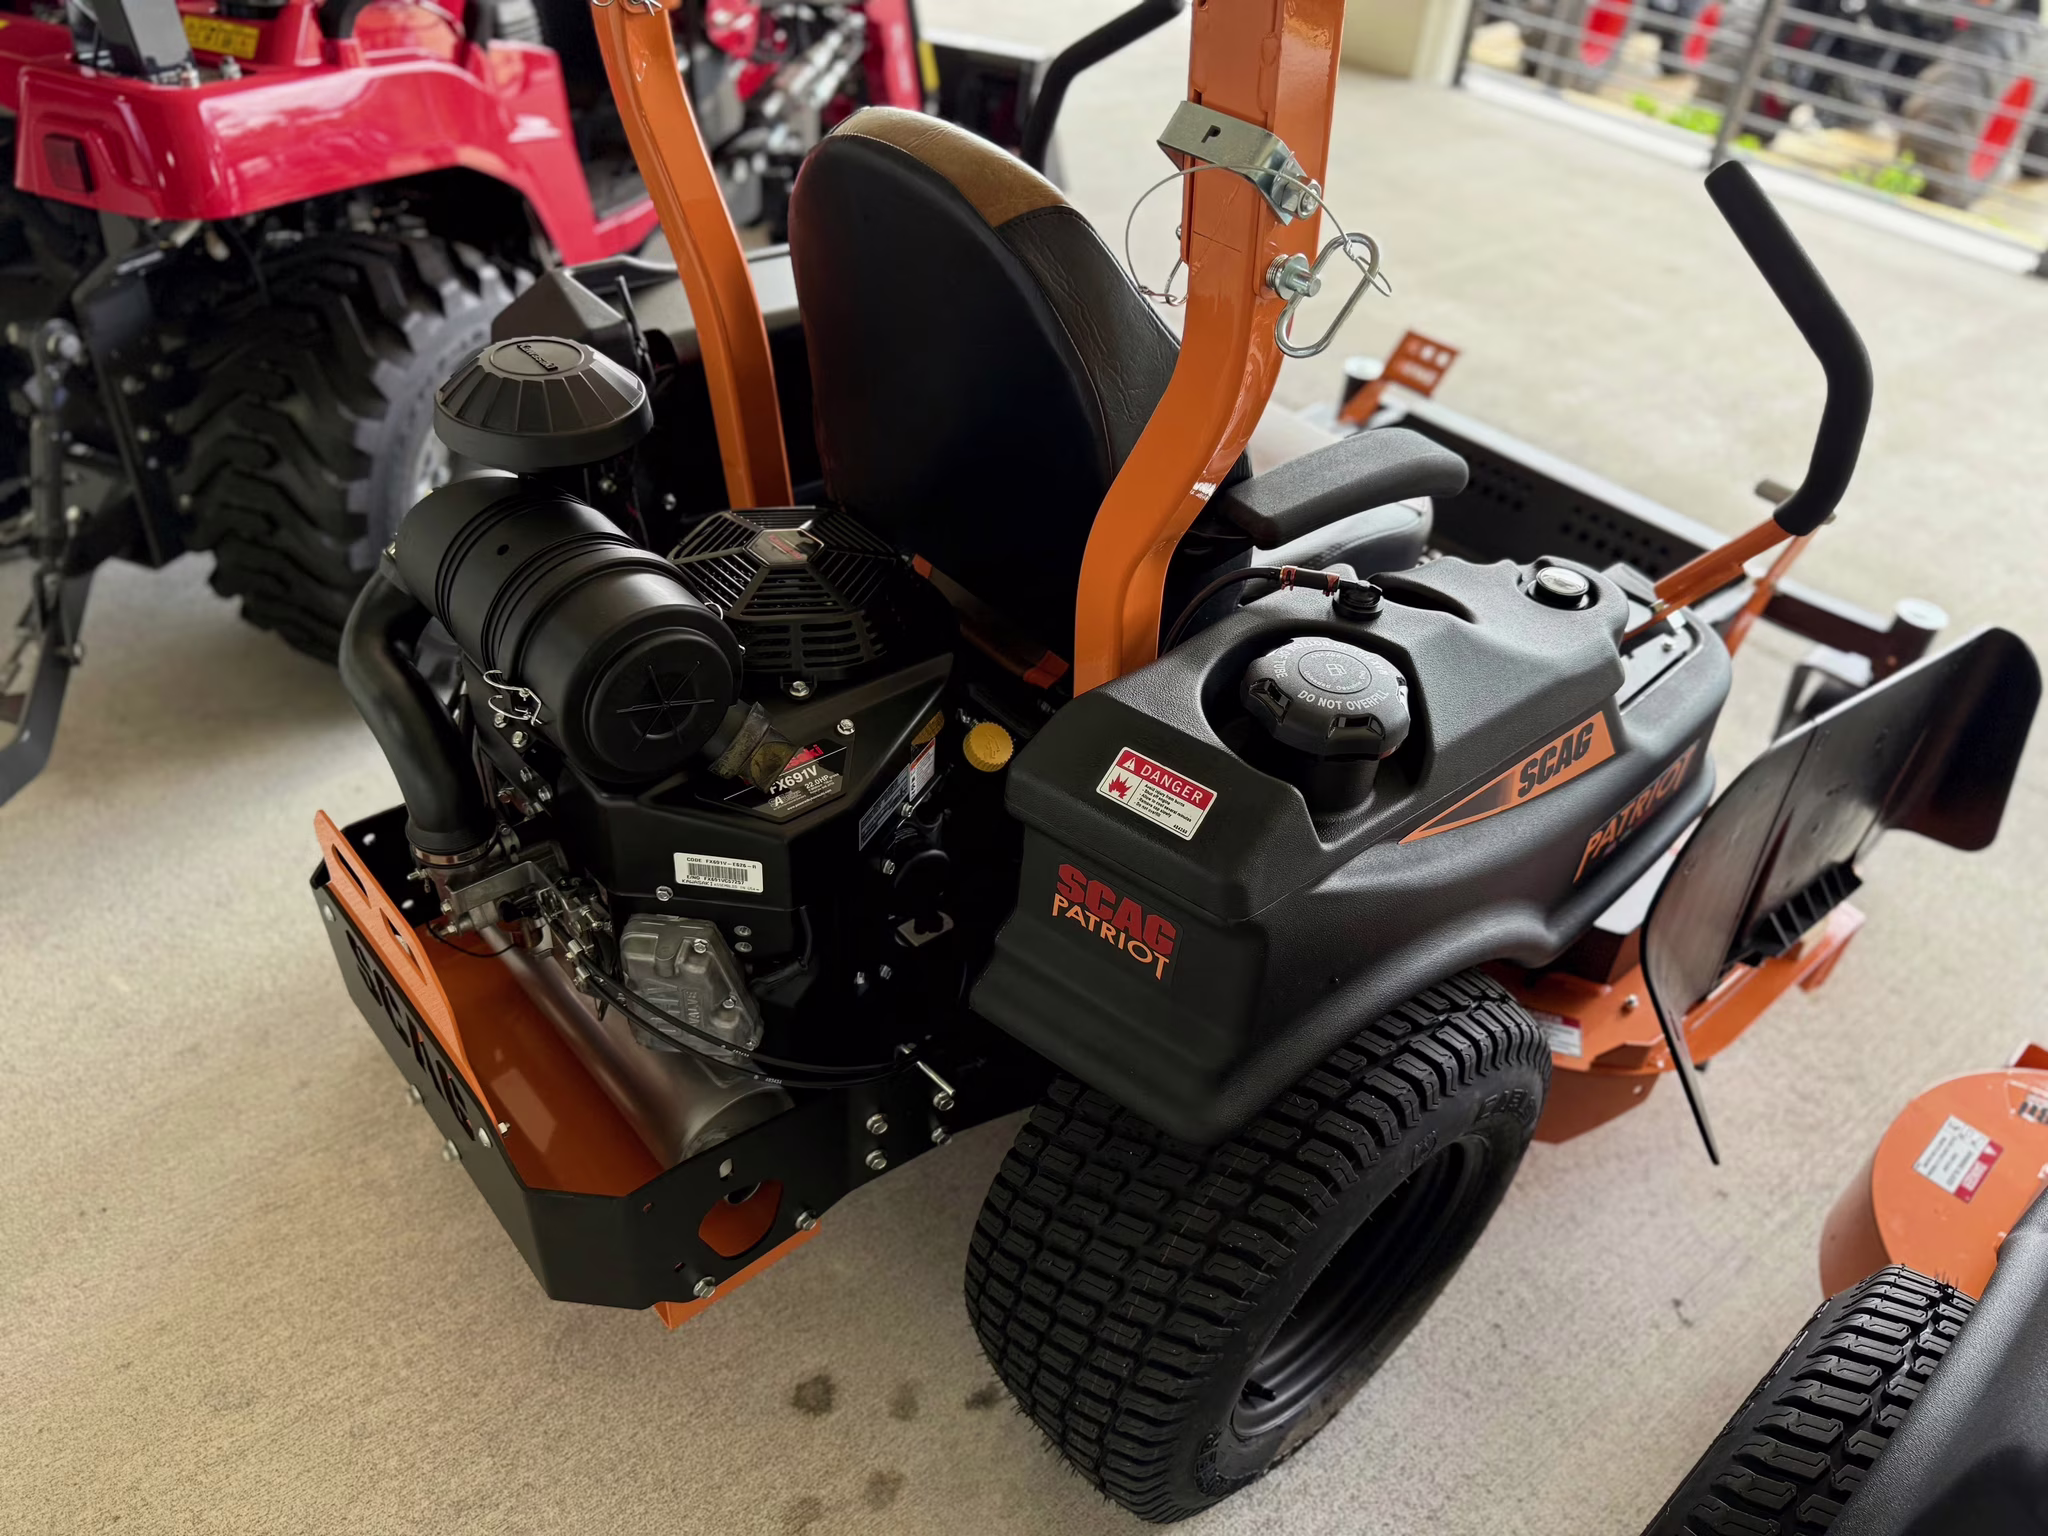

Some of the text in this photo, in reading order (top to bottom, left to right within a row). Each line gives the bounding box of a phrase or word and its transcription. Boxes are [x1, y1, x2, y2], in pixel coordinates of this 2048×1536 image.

[1273, 660, 1288, 679] TUBE
[1297, 689, 1389, 710] DO NOT OVERFILL
[769, 765, 818, 795] FX691V
[1140, 764, 1203, 803] DANGER
[1517, 722, 1595, 798] SCAG
[1158, 797, 1170, 805] engine
[1573, 742, 1700, 884] PATRIOT
[1052, 893, 1170, 981] PATRIOT
[1057, 863, 1177, 956] SCAG
[346, 930, 475, 1141] SCAG
